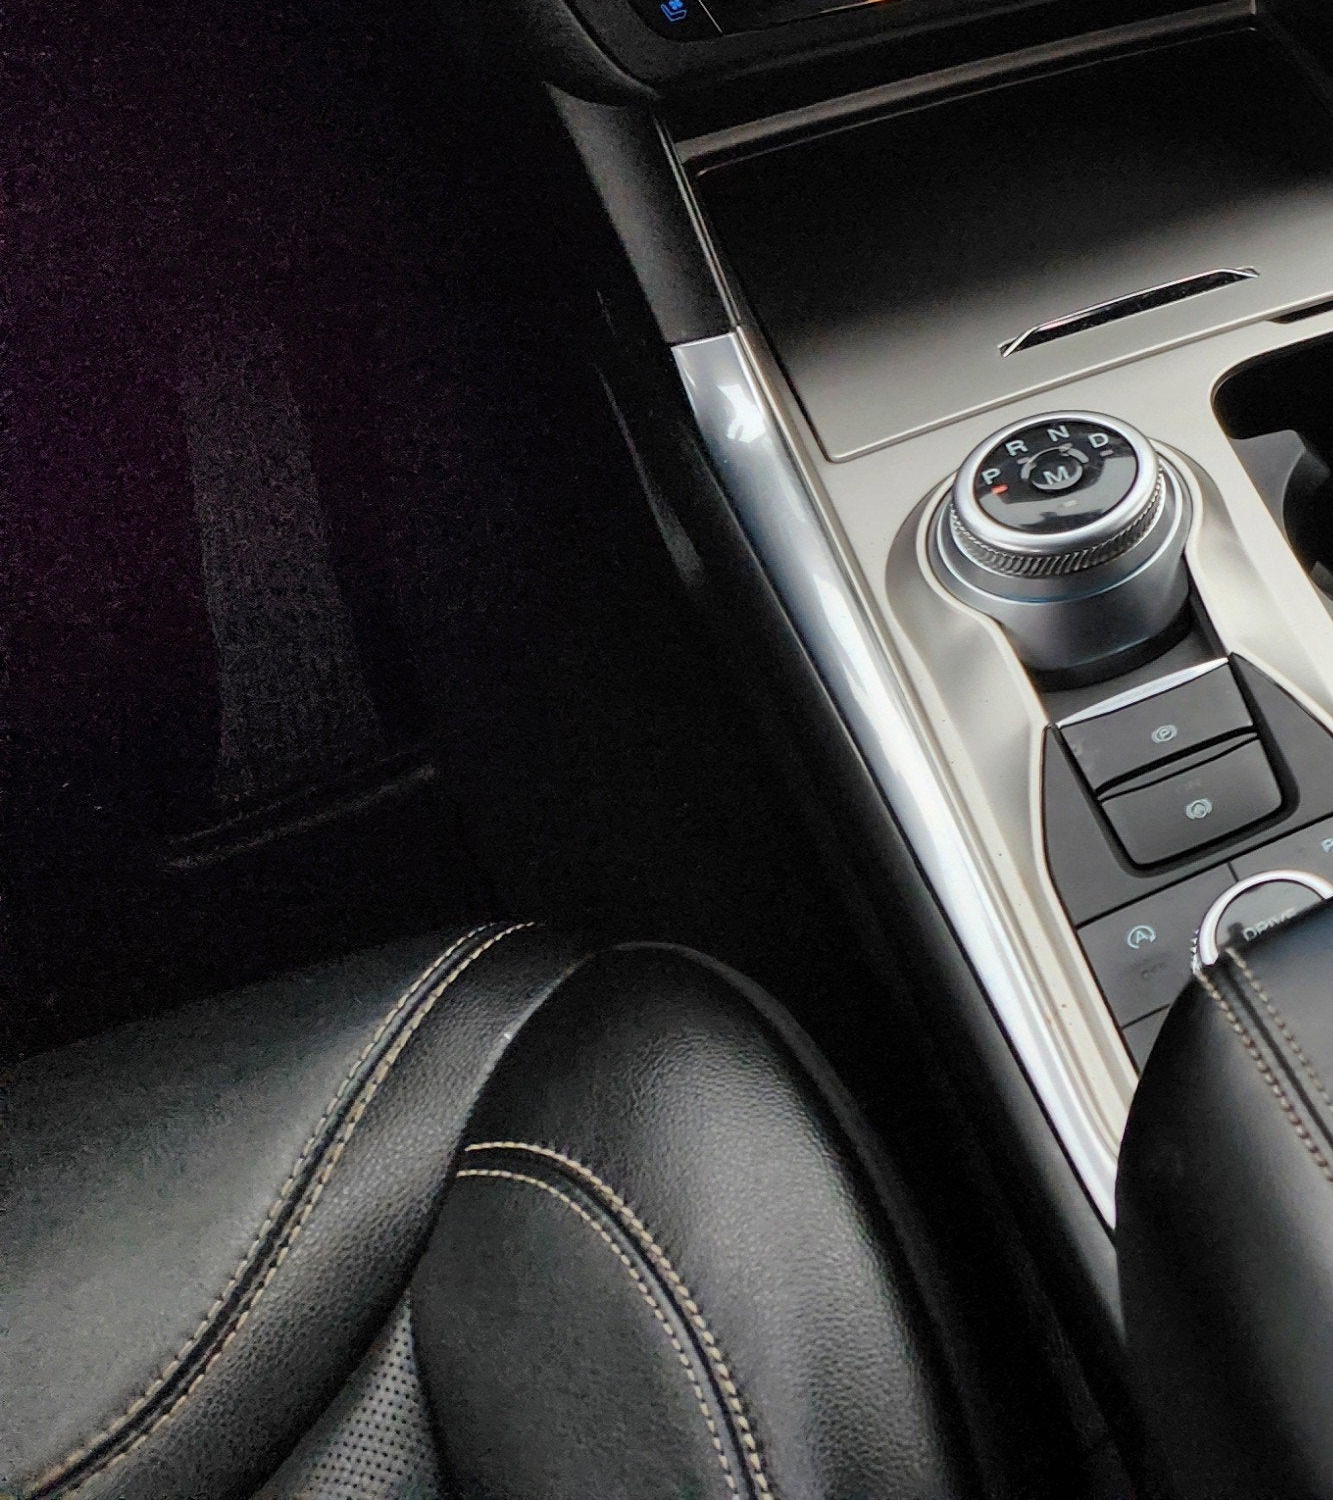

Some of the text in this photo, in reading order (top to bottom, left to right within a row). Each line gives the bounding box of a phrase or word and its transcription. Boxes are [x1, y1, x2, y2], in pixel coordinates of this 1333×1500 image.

[982, 425, 1109, 485] P R N D
[1043, 465, 1070, 485] M
